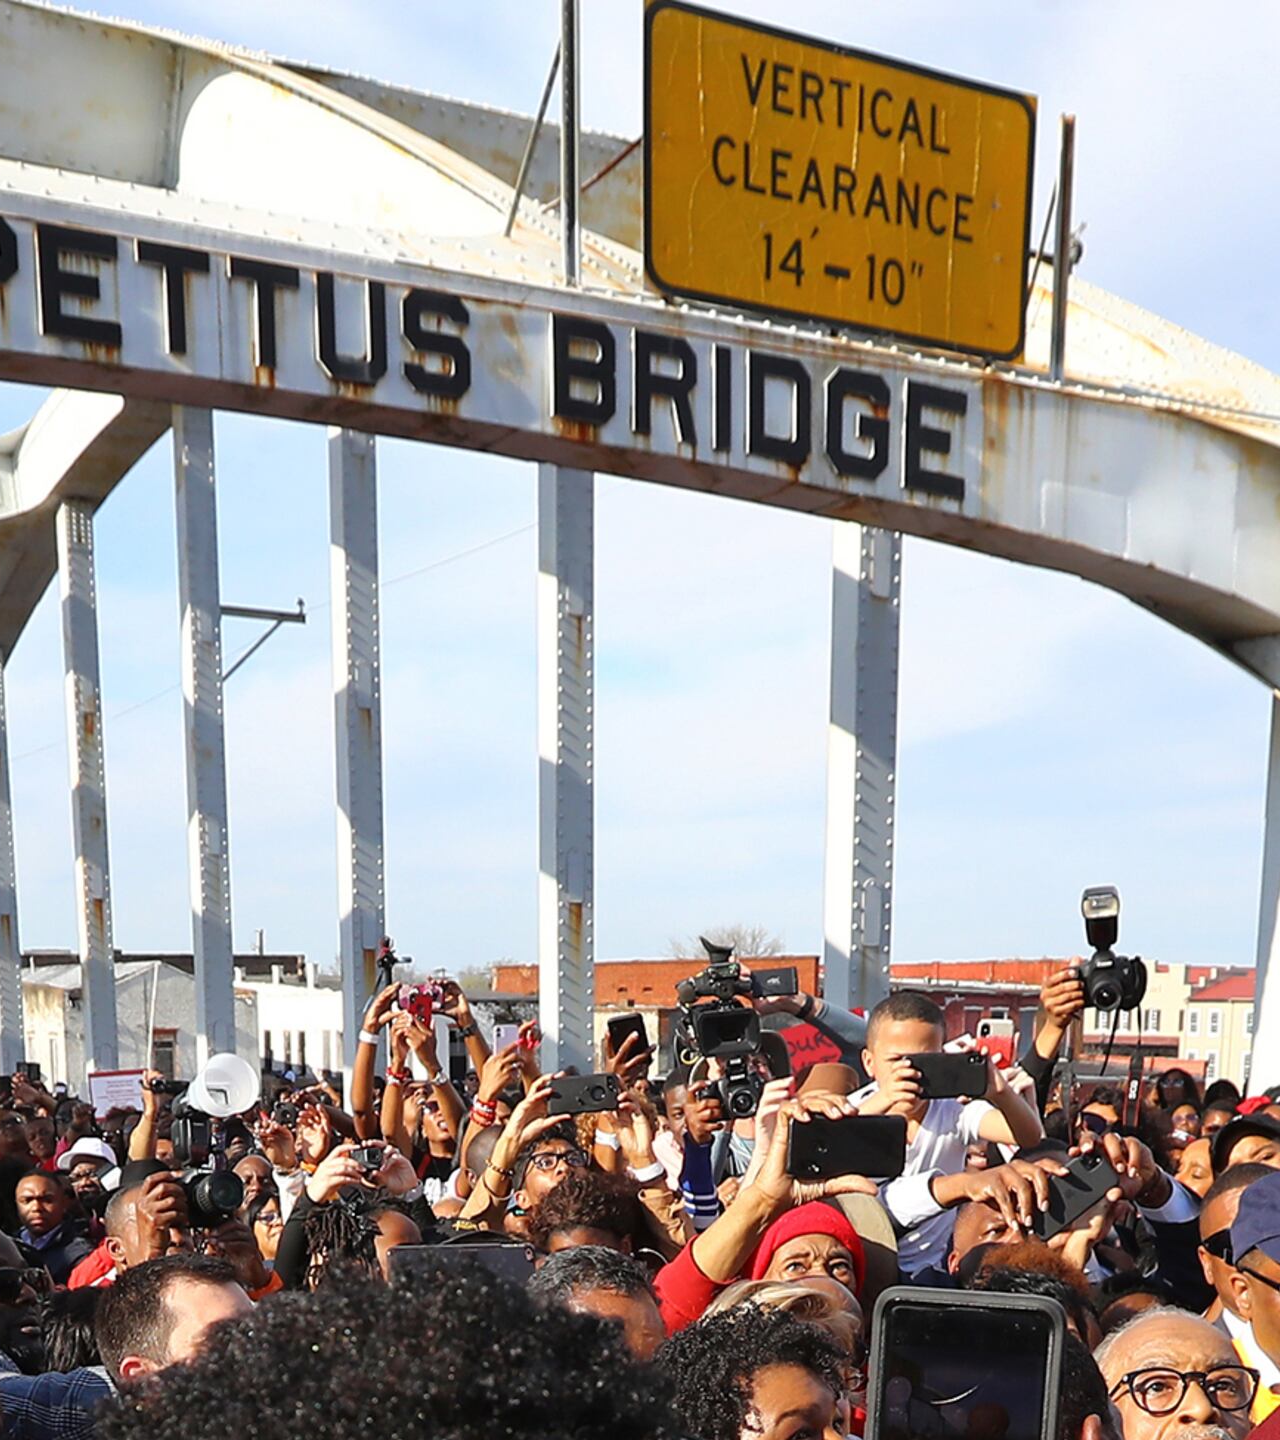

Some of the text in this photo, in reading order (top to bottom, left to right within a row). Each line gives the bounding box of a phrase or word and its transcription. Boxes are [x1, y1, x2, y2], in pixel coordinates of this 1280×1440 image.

[739, 57, 951, 157] VERTICAL
[711, 135, 975, 243] CLEARANCE
[551, 312, 968, 502] BRIDGE
